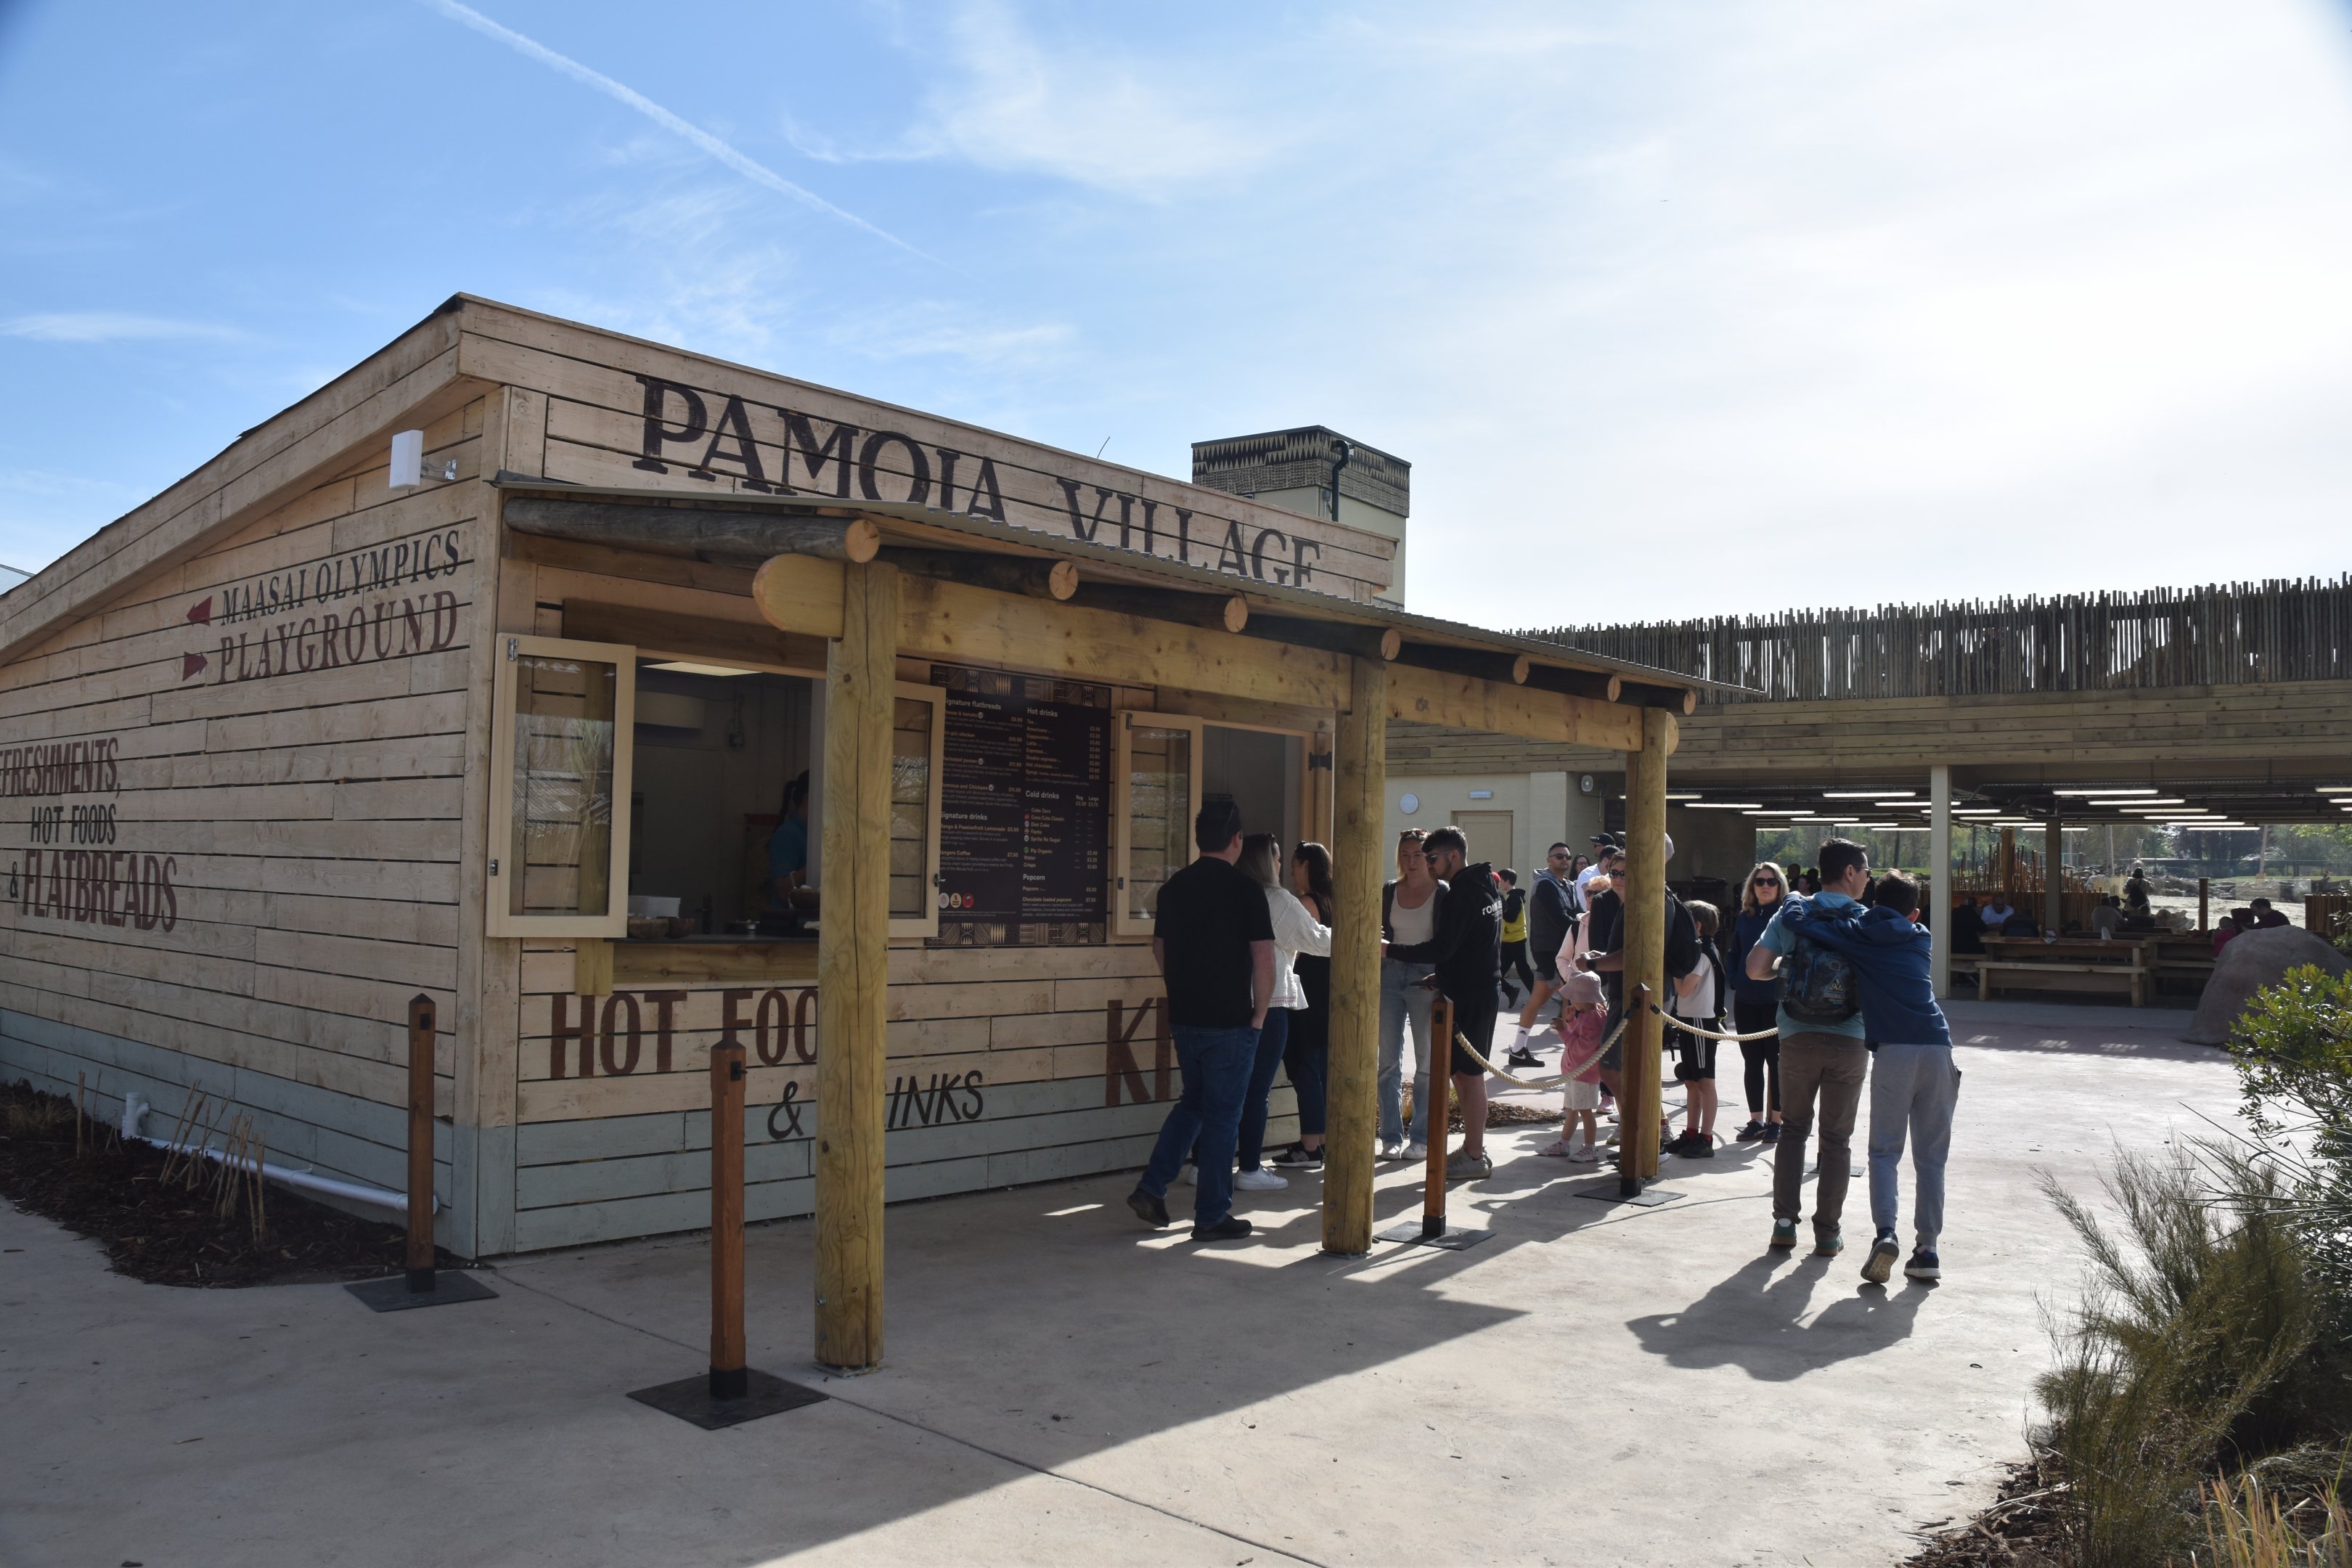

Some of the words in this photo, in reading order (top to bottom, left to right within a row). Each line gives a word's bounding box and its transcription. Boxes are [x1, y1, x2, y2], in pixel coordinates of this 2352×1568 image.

[1056, 476, 1320, 587] VILLAGE
[221, 567, 307, 626] MAASAI
[315, 529, 460, 604] OLYMPICS
[219, 589, 458, 684] PLAYGROUND
[945, 698, 971, 708] ignature
[972, 700, 1002, 711] flatbreads
[1027, 706, 1038, 716] Hot
[1040, 709, 1058, 717] drinks
[0, 737, 121, 799] FRESHMENTS,
[1025, 789, 1040, 799] Cold
[1040, 791, 1060, 800] drinks
[30, 806, 64, 844] HOT
[70, 803, 117, 845] FOODS
[969, 812, 988, 821] drinks
[9, 861, 19, 899] &
[23, 849, 177, 933] FLATBREADS
[1023, 873, 1045, 882] Popcorn
[550, 991, 687, 1079] HOT
[722, 989, 818, 1065] FOO
[1106, 997, 1172, 1108] KI
[767, 1080, 804, 1140] &
[884, 1070, 983, 1129] INKS
